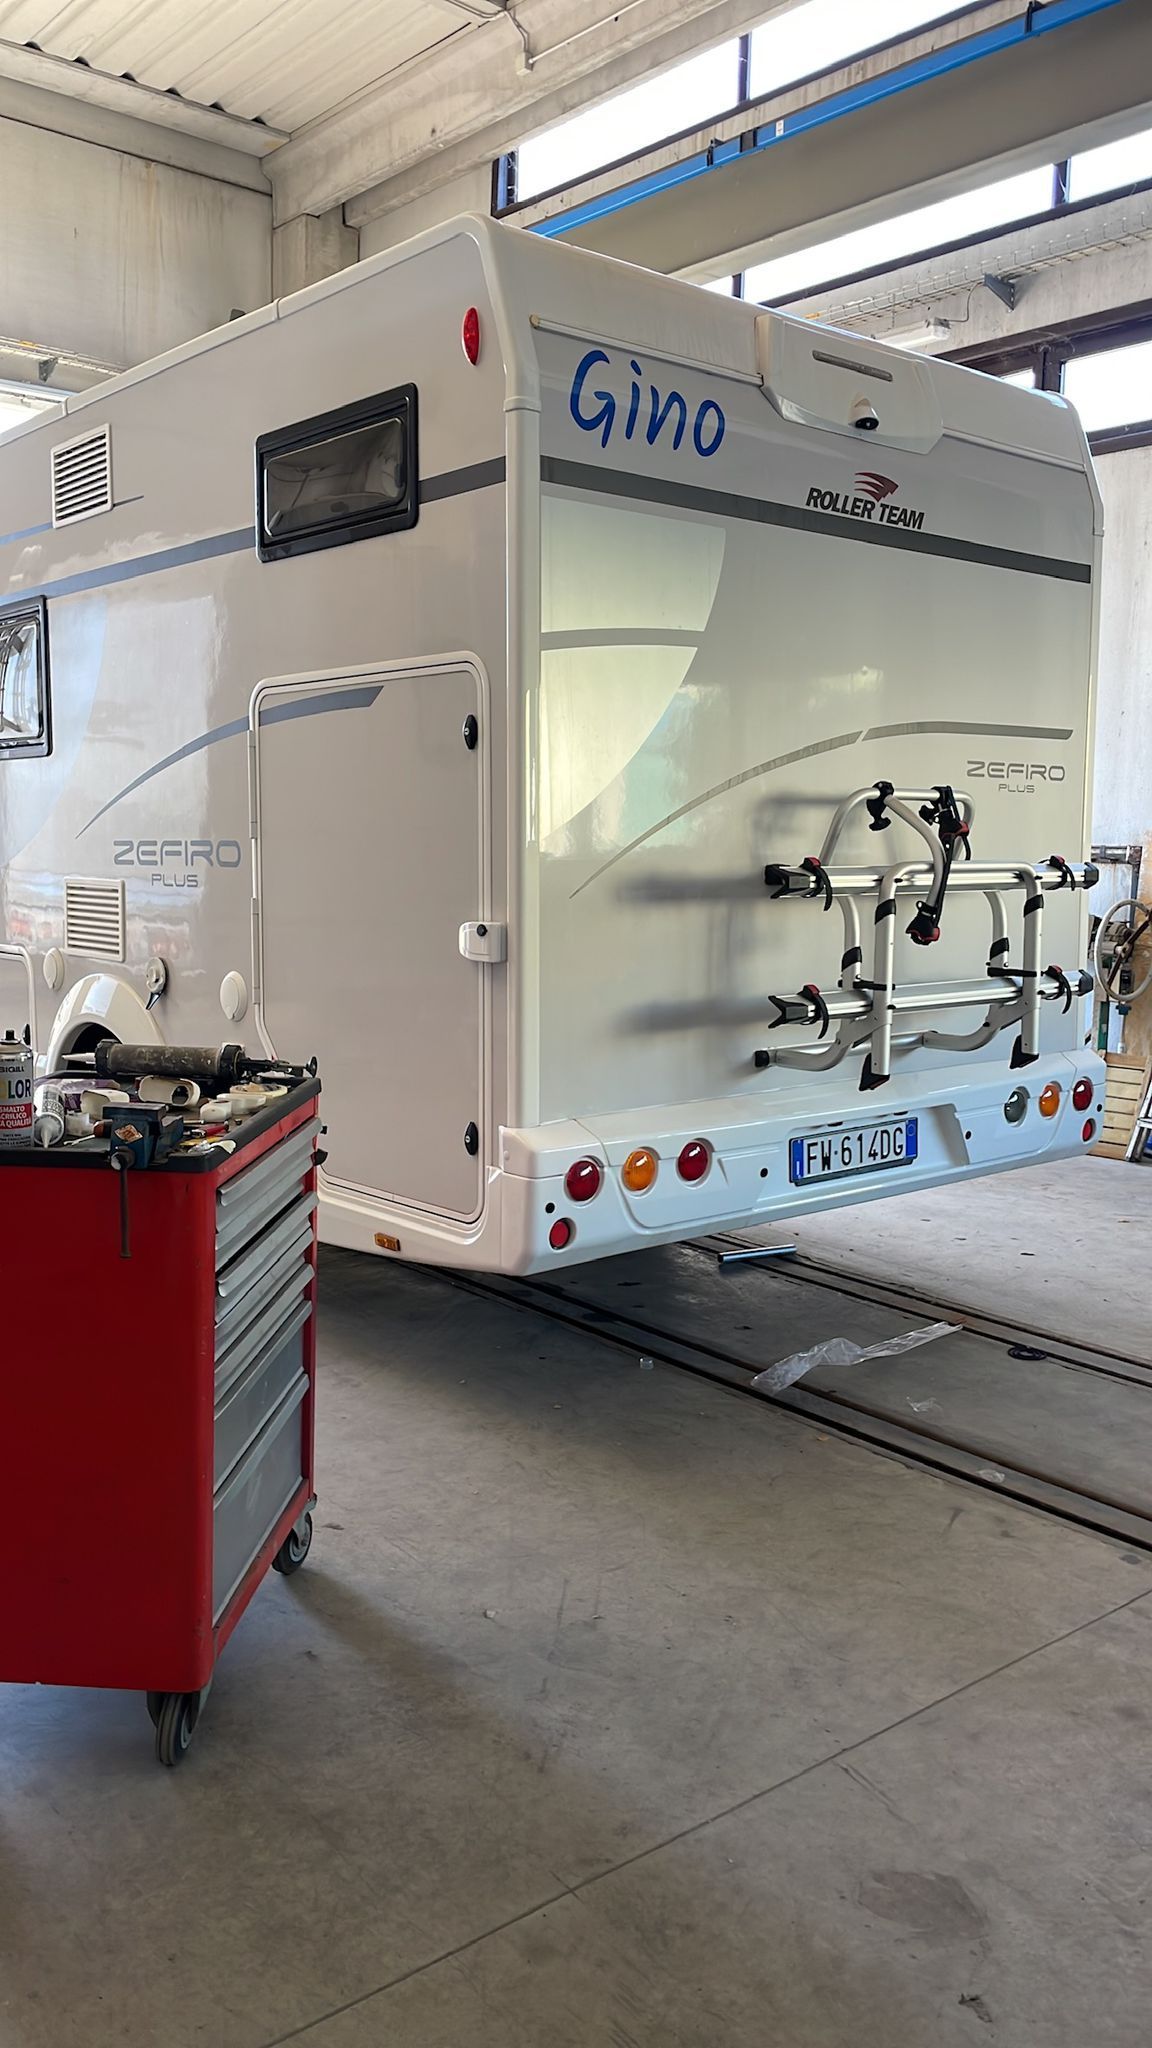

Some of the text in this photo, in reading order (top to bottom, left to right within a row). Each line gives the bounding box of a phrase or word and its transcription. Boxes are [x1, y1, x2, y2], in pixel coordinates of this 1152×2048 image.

[570, 350, 725, 457] Gino
[805, 487, 925, 530] ROLLER TEAM
[966, 760, 1065, 781] ZEFIRO
[998, 783, 1035, 793] PLUS
[113, 840, 241, 868] ZEFIRO
[151, 873, 198, 888] PLUS
